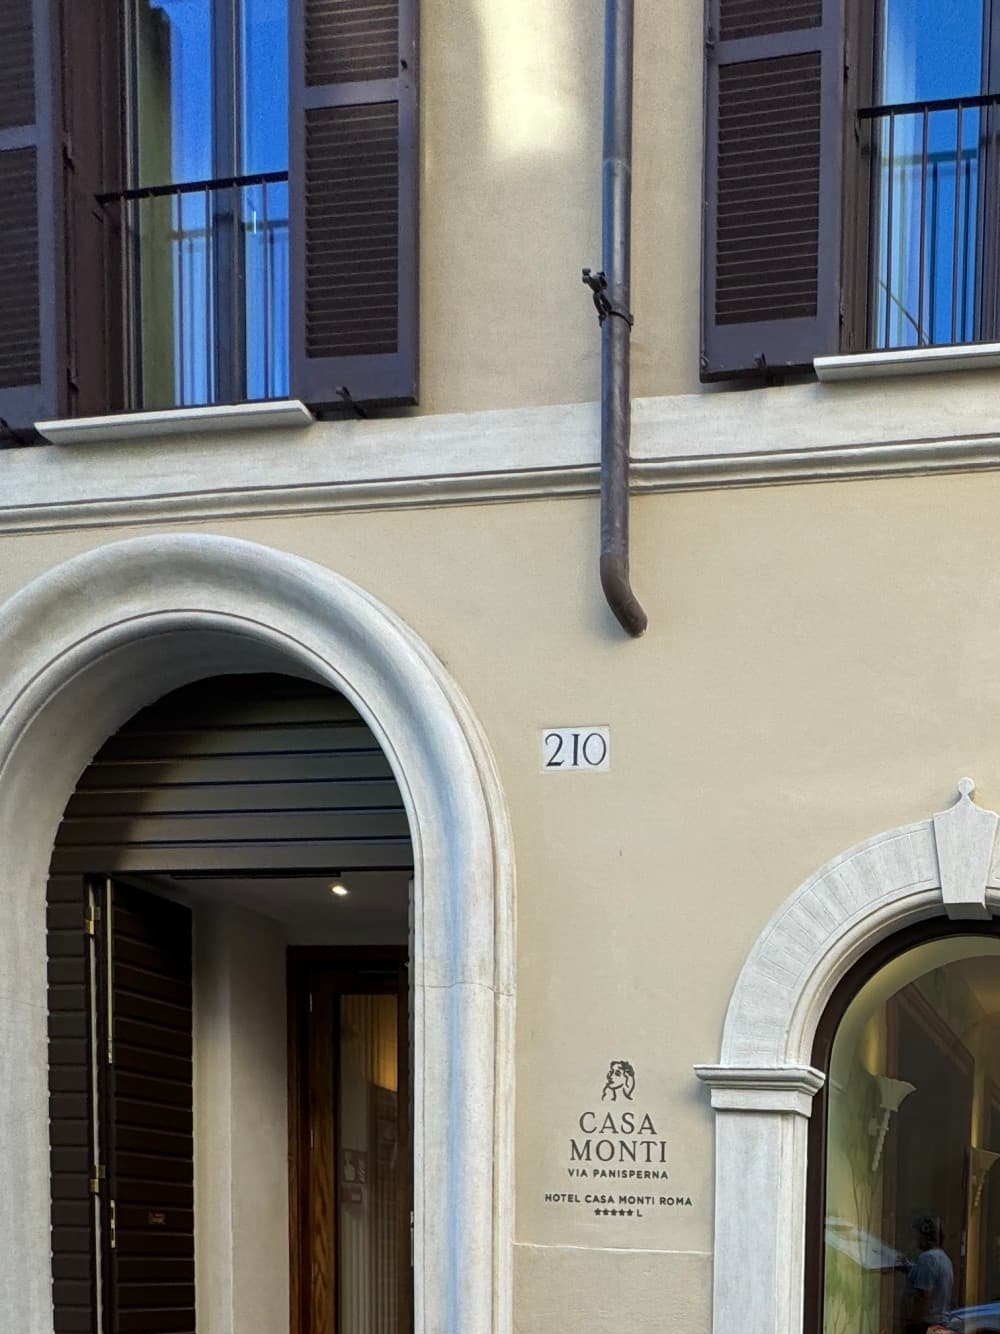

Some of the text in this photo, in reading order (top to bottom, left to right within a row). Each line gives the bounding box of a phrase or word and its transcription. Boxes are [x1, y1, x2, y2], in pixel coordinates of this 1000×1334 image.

[544, 732, 607, 767] 210
[579, 1111, 657, 1135] CASA
[570, 1138, 667, 1163] MONTI
[567, 1168, 669, 1180] VIA PANISPERNA
[544, 1193, 693, 1206] HOTEL CASA MONTI ROMA
